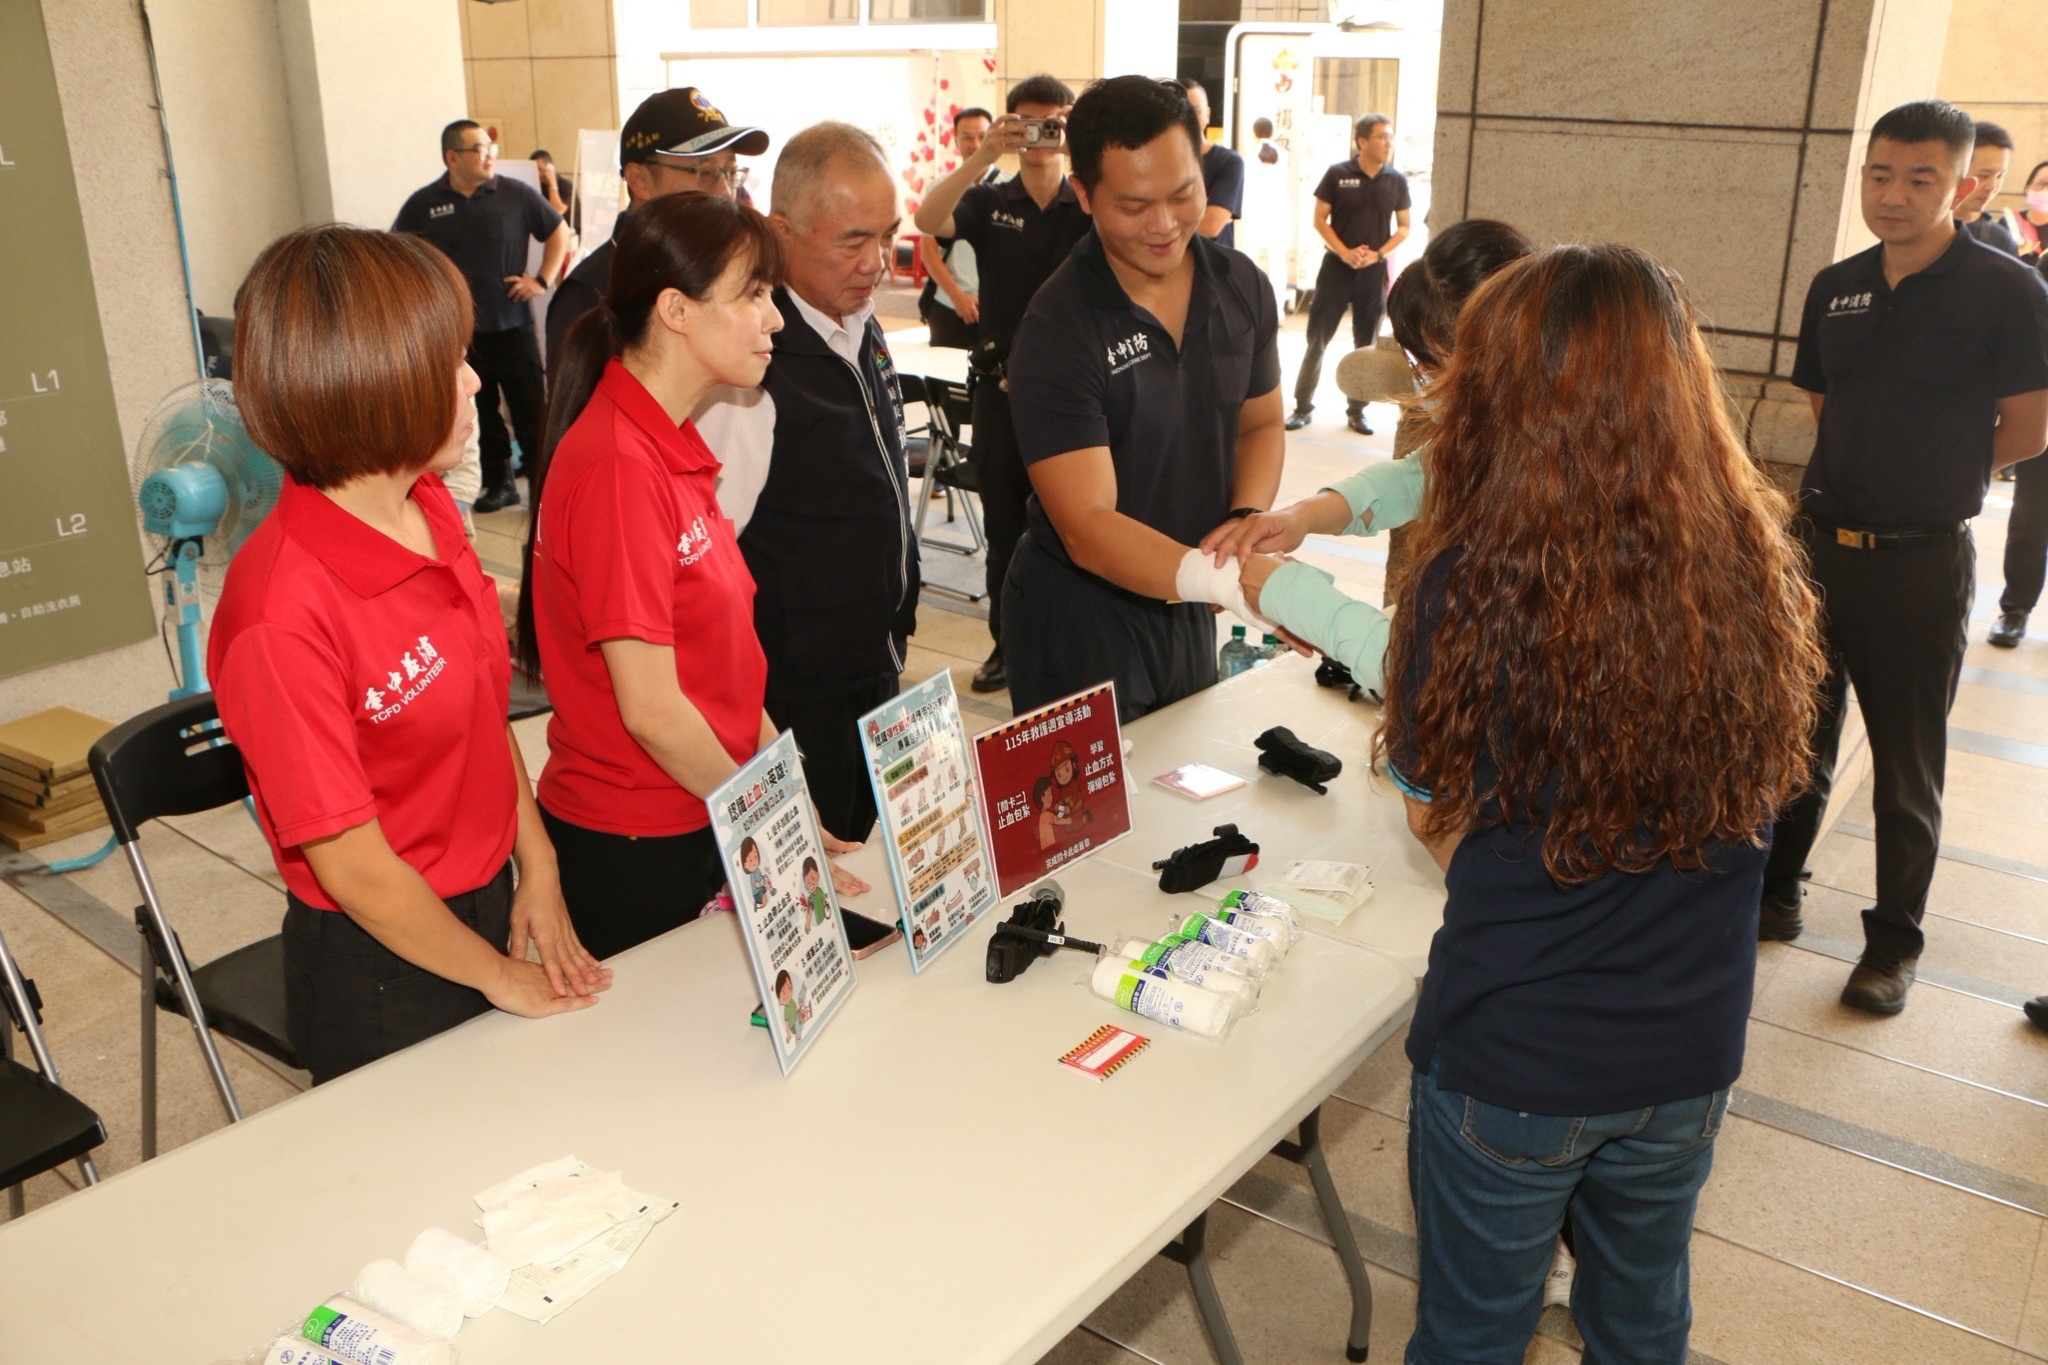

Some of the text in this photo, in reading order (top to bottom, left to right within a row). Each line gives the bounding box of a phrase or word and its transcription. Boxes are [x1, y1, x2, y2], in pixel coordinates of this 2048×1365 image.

[31, 369, 60, 393] L1
[56, 513, 87, 537] L2
[370, 657, 447, 724] TCFD VOLUNTEER
[1005, 704, 1091, 751] 115年救護週宣導活動
[1085, 753, 1114, 776] 止血方式
[998, 805, 1031, 830] 止血包紮
